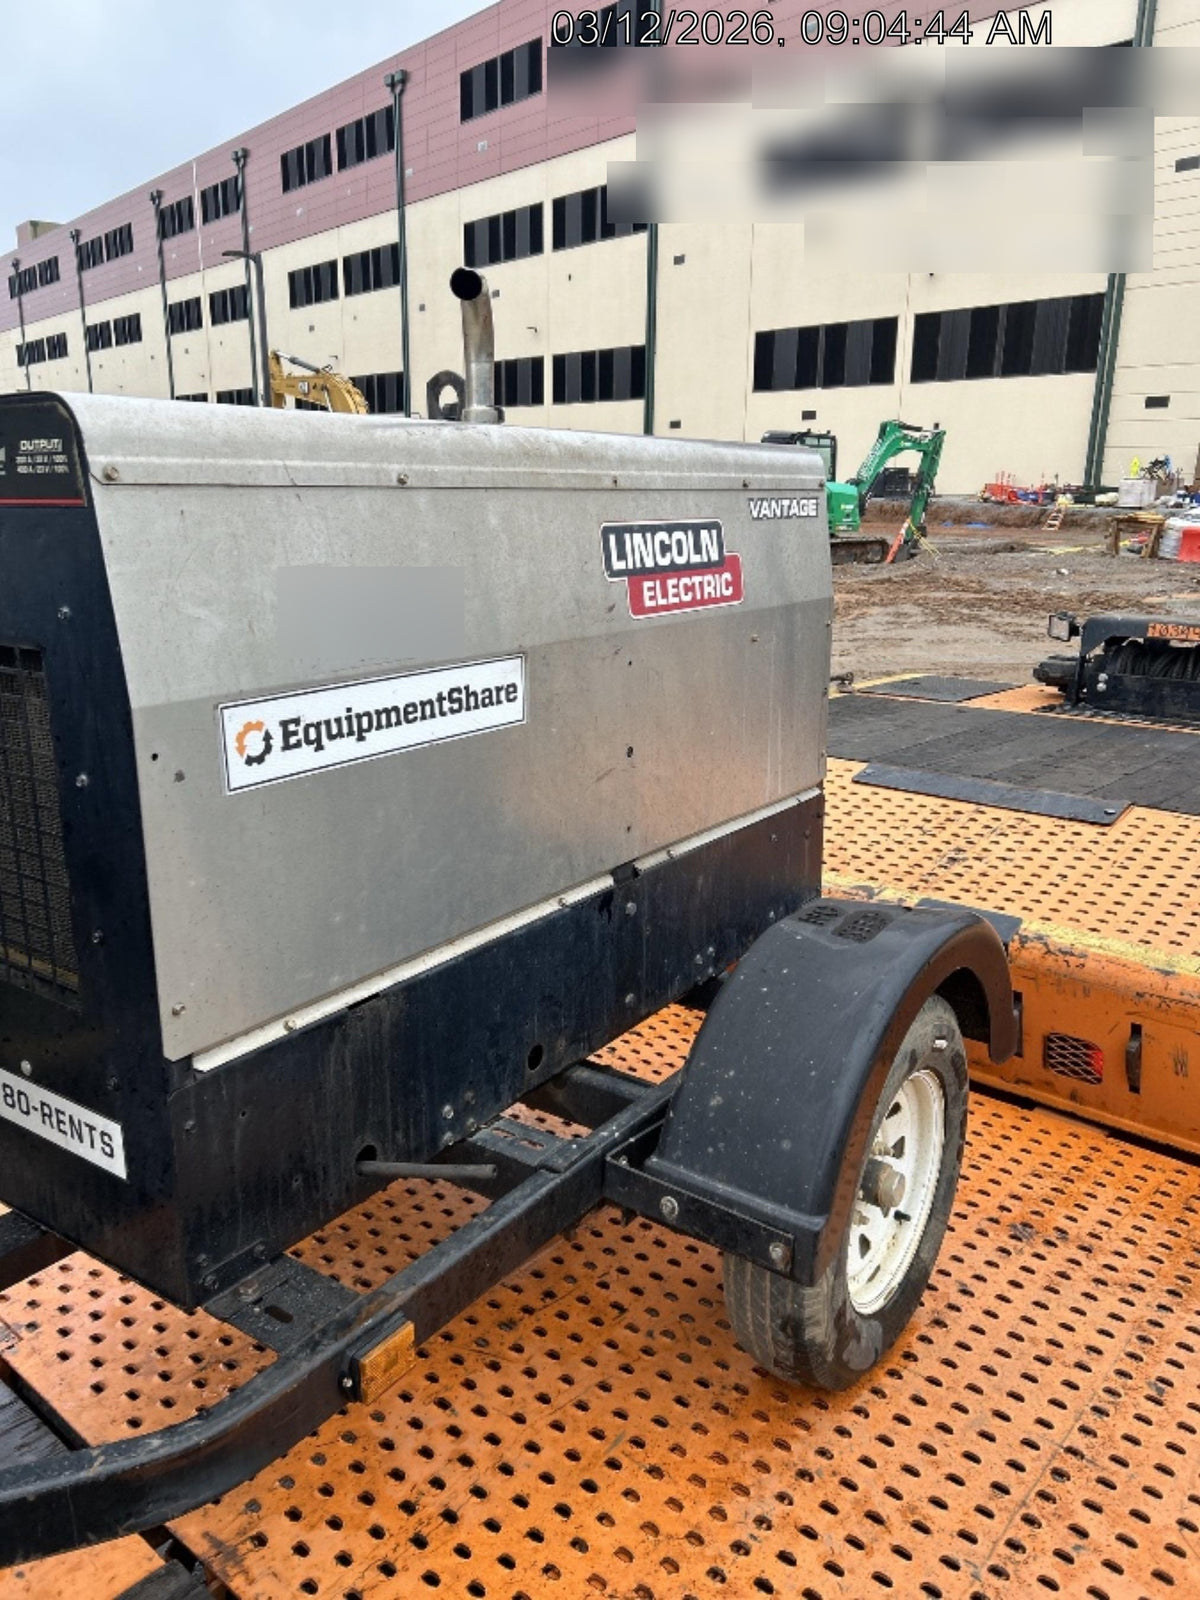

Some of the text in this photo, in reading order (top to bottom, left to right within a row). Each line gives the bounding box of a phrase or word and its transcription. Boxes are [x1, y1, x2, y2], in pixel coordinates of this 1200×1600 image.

[19, 438, 61, 451] OUTPUT
[749, 498, 819, 519] VANTAGE
[608, 528, 720, 571] LINCOLN
[642, 572, 734, 608] ELECTRIC
[278, 681, 519, 753] EquipmentShare
[1, 1082, 115, 1159] 80-RENTS
